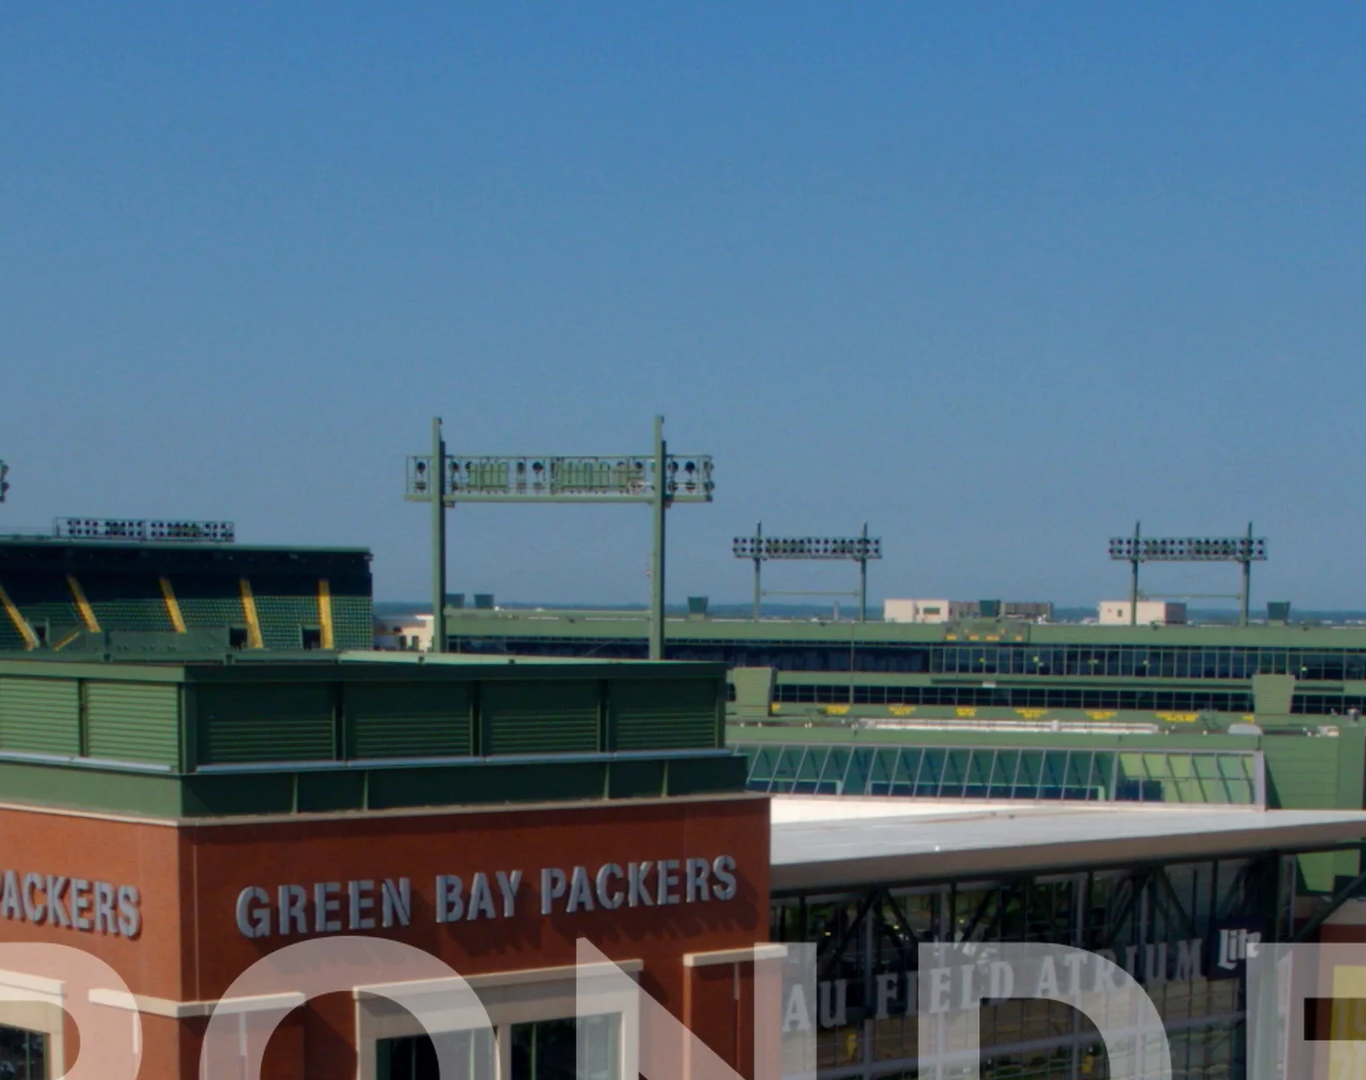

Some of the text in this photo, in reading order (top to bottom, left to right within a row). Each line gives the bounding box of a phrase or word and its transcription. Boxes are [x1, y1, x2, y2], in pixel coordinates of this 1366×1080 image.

[235, 855, 735, 938] GREEN BAY PACKERS
[874, 960, 1014, 1020] FIELD
[1035, 938, 1206, 997] ATRIUM
[1218, 929, 1261, 970] Lite
